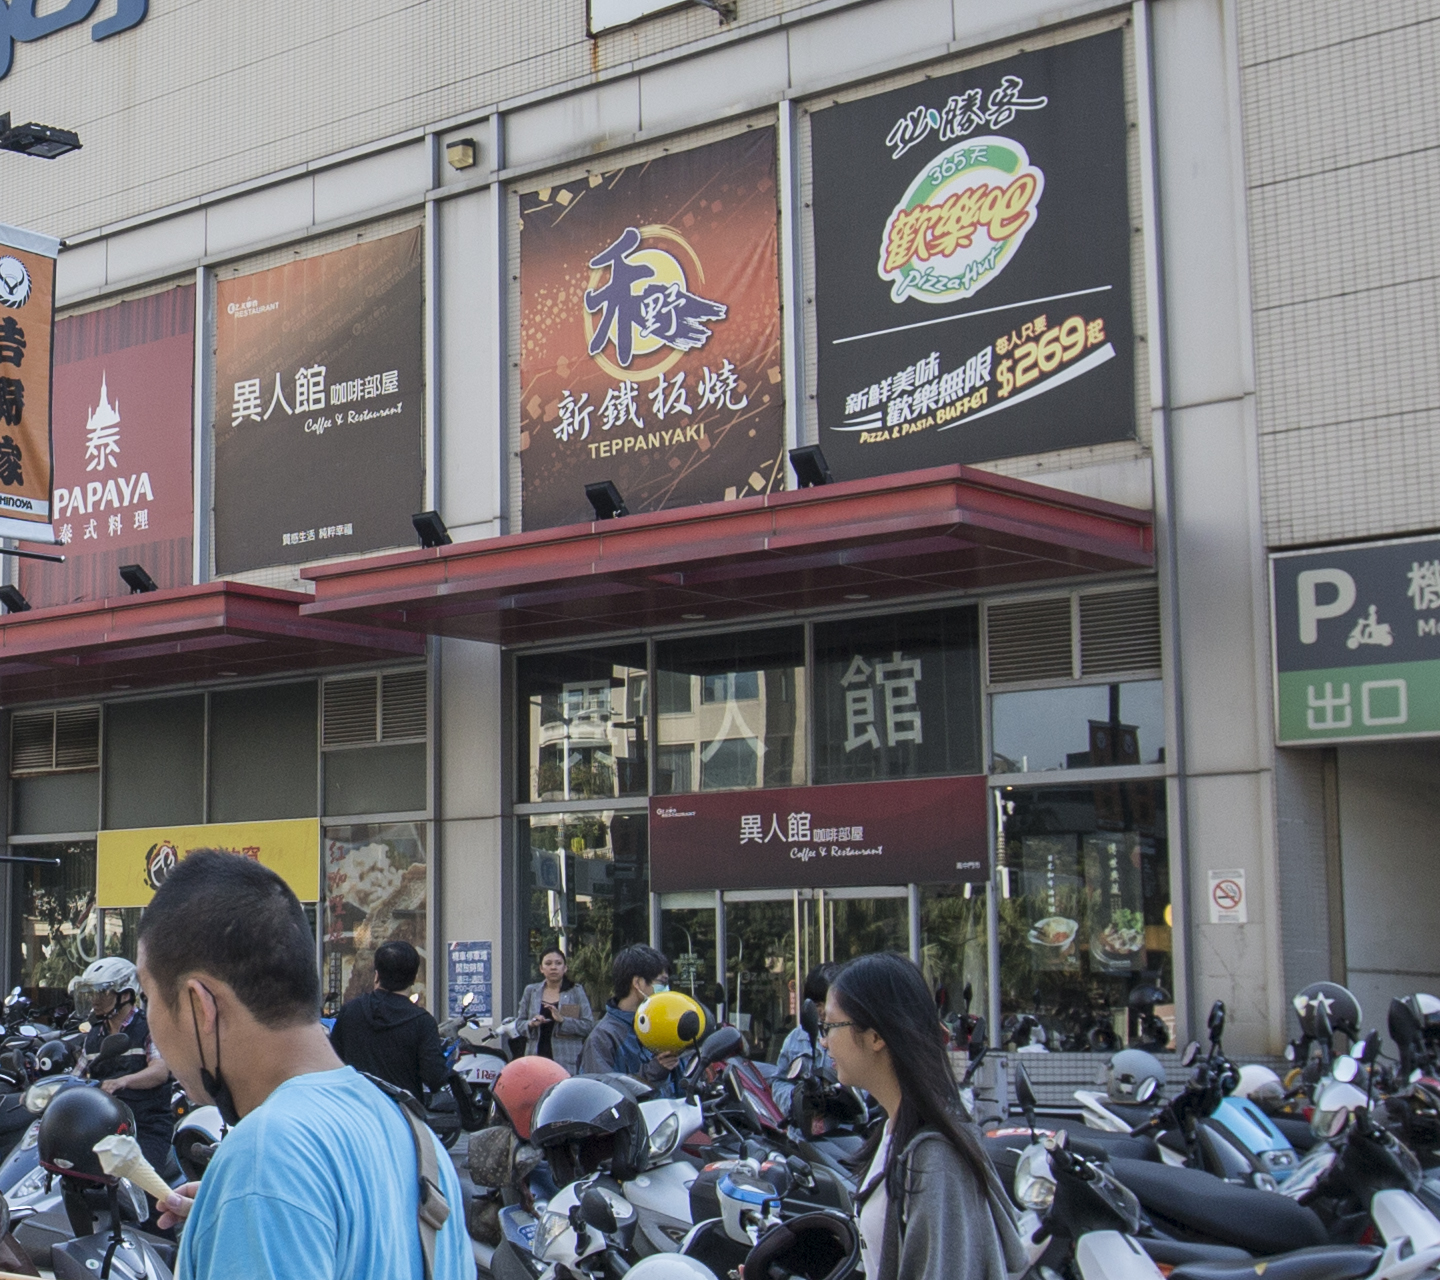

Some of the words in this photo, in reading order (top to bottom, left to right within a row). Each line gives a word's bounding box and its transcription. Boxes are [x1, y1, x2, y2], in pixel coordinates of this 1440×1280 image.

[928, 145, 989, 186] 365天
[897, 269, 961, 295] Pizza
[961, 246, 1003, 288] Hut
[995, 314, 1048, 356] 每人只要
[231, 363, 327, 428] 異人館
[329, 370, 400, 408] 咖啡部屋
[552, 358, 749, 444] 新鐵板燒
[844, 351, 941, 416] 新鮮美味
[886, 345, 993, 428] 歡樂無限
[304, 411, 333, 435] Coffee
[347, 402, 404, 426] Restaurant
[891, 427, 901, 439] &
[587, 422, 707, 461] TEPPANYAKI
[52, 471, 155, 520] PAPAYA
[57, 508, 150, 546] 泰式料理
[1296, 567, 1357, 645] P
[1305, 677, 1409, 731] 出口
[740, 811, 812, 846] 異人館
[812, 825, 865, 844] 咖啡部屋
[789, 846, 817, 863] Coffee
[830, 845, 883, 858] Restaurant
